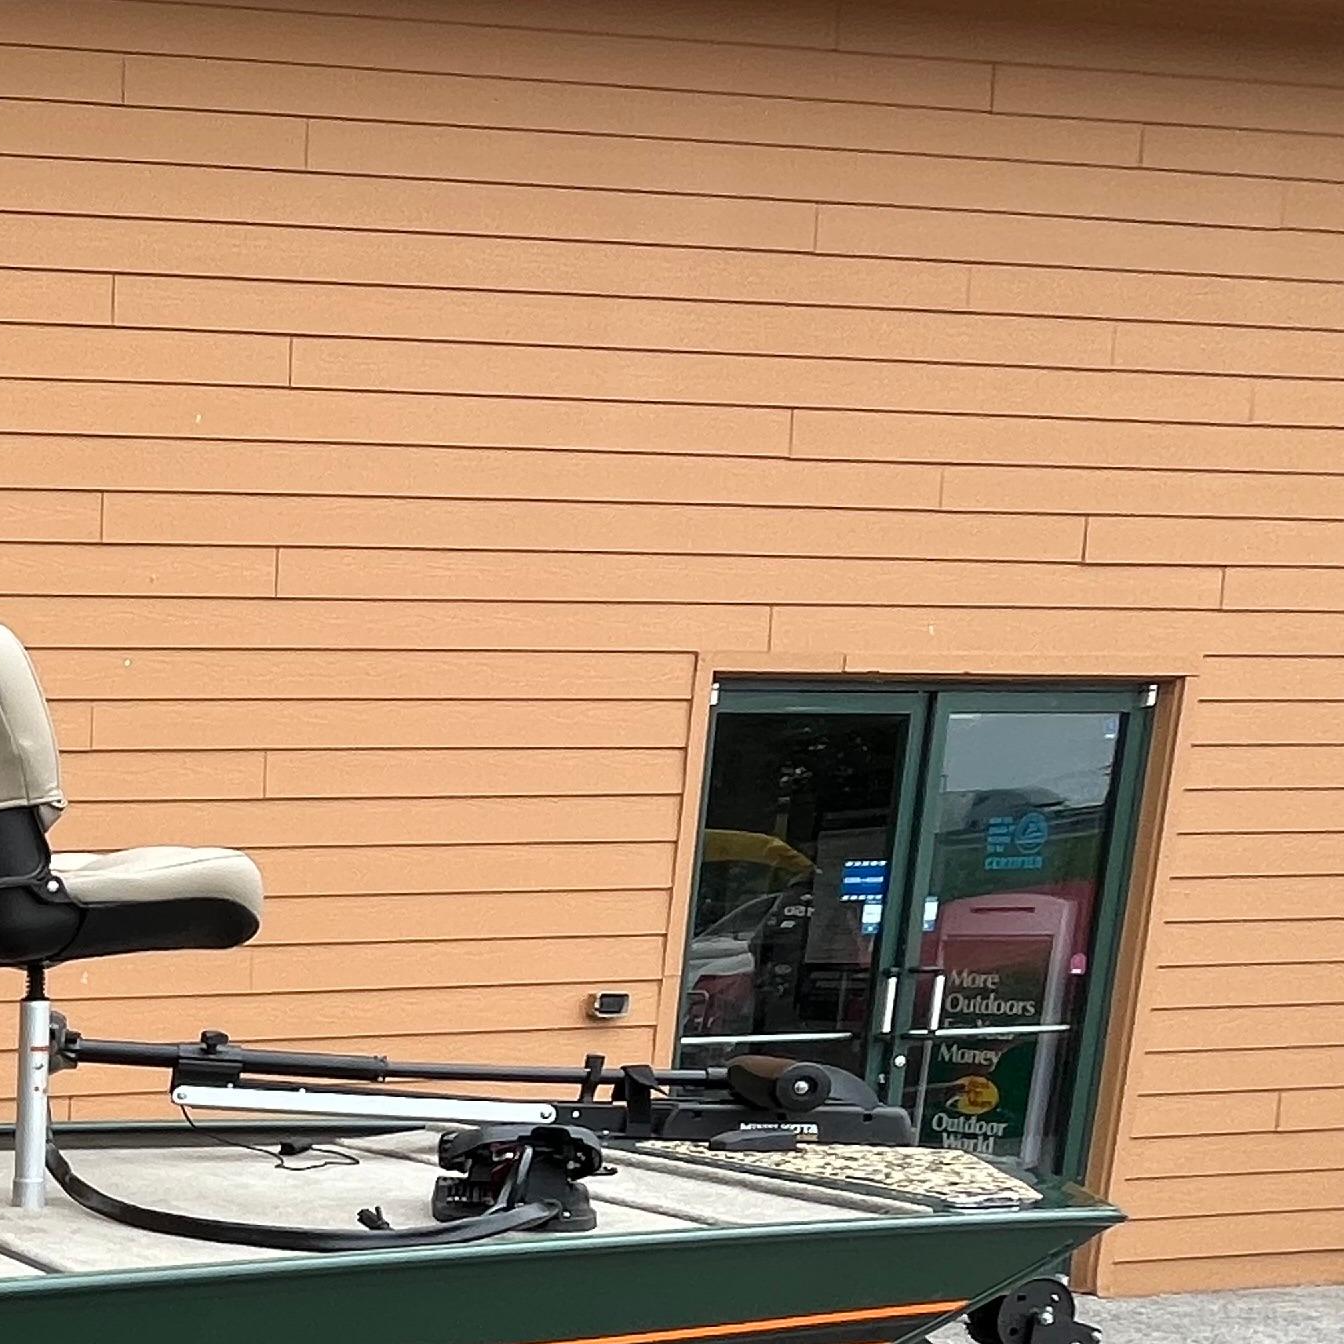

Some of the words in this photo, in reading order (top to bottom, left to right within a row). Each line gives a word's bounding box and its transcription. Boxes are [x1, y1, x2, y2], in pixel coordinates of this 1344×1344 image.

[950, 968, 1000, 989] More
[945, 992, 1036, 1016] Outdoors
[937, 1042, 1003, 1071] Money
[932, 1112, 1009, 1136] Outdoor
[942, 1132, 995, 1154] World
